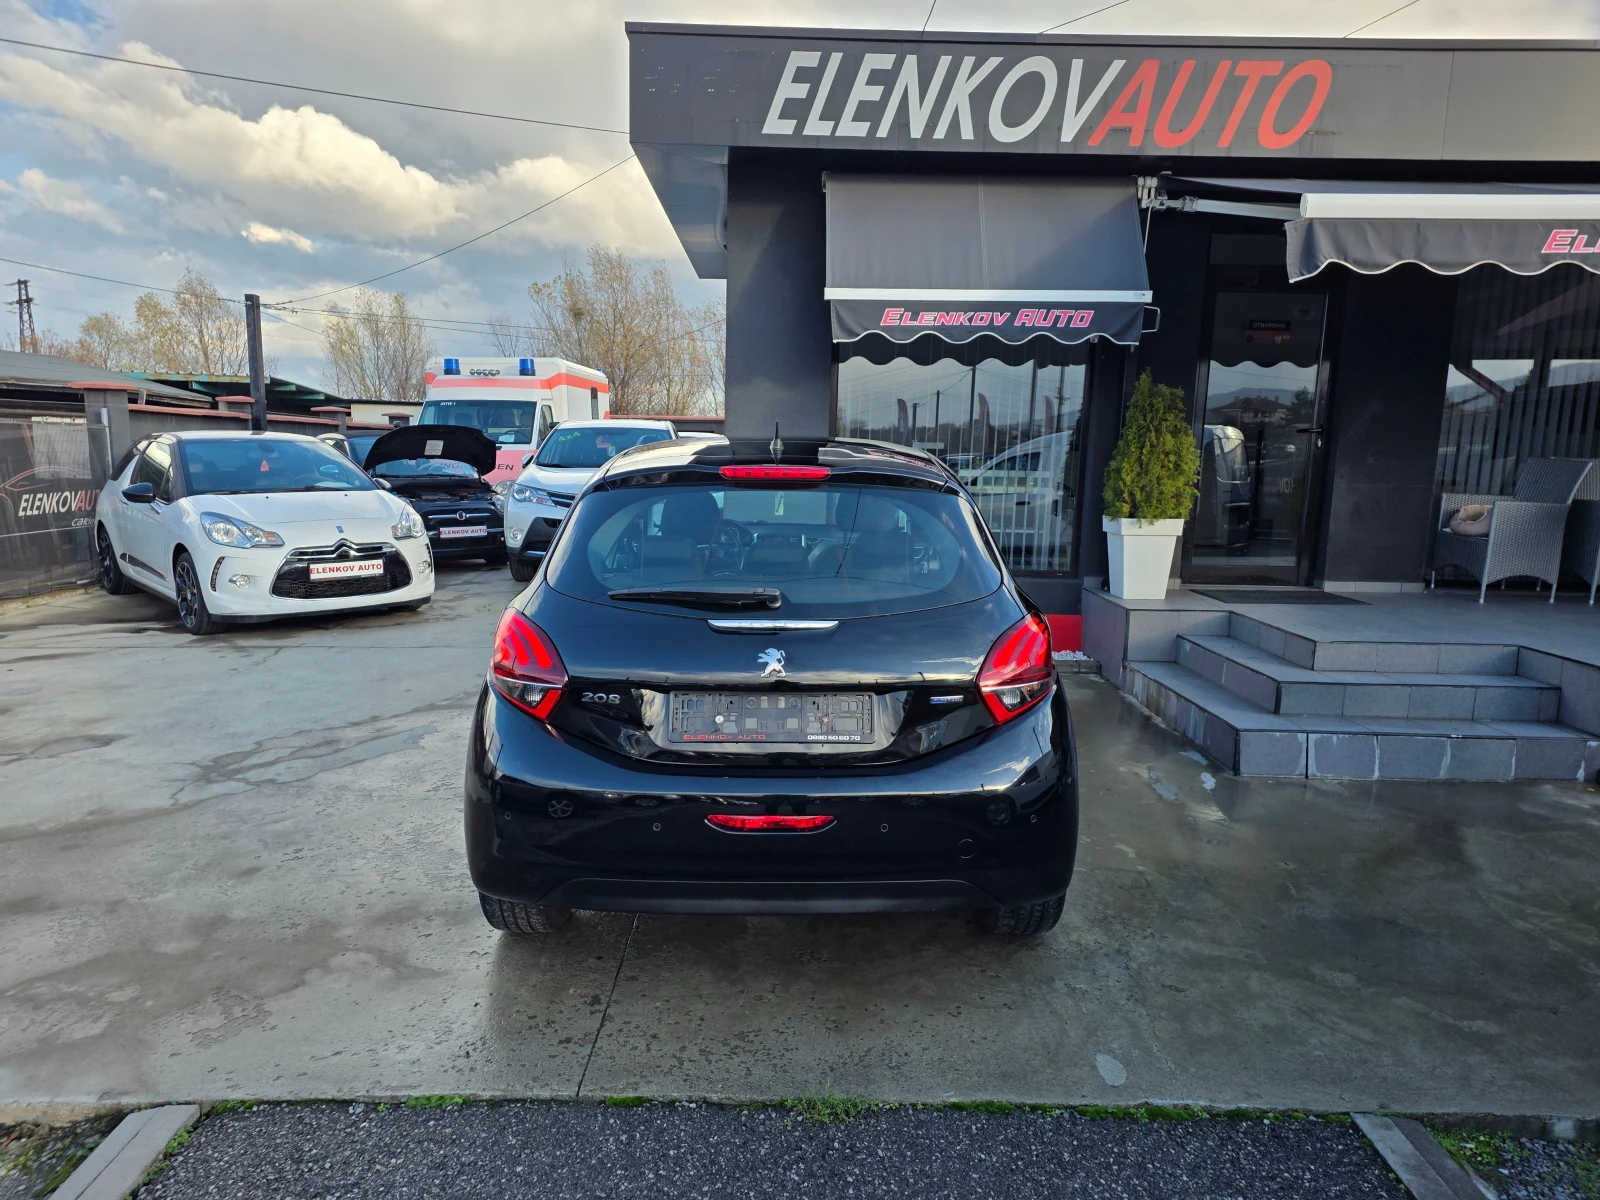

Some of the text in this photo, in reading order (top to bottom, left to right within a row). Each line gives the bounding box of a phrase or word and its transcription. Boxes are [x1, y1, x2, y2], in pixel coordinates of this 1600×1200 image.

[1014, 309, 1095, 327] AUTO
[18, 489, 101, 517] ELENKOVAUT
[310, 563, 382, 574] ELENKOV AUTO
[581, 692, 620, 704] 208
